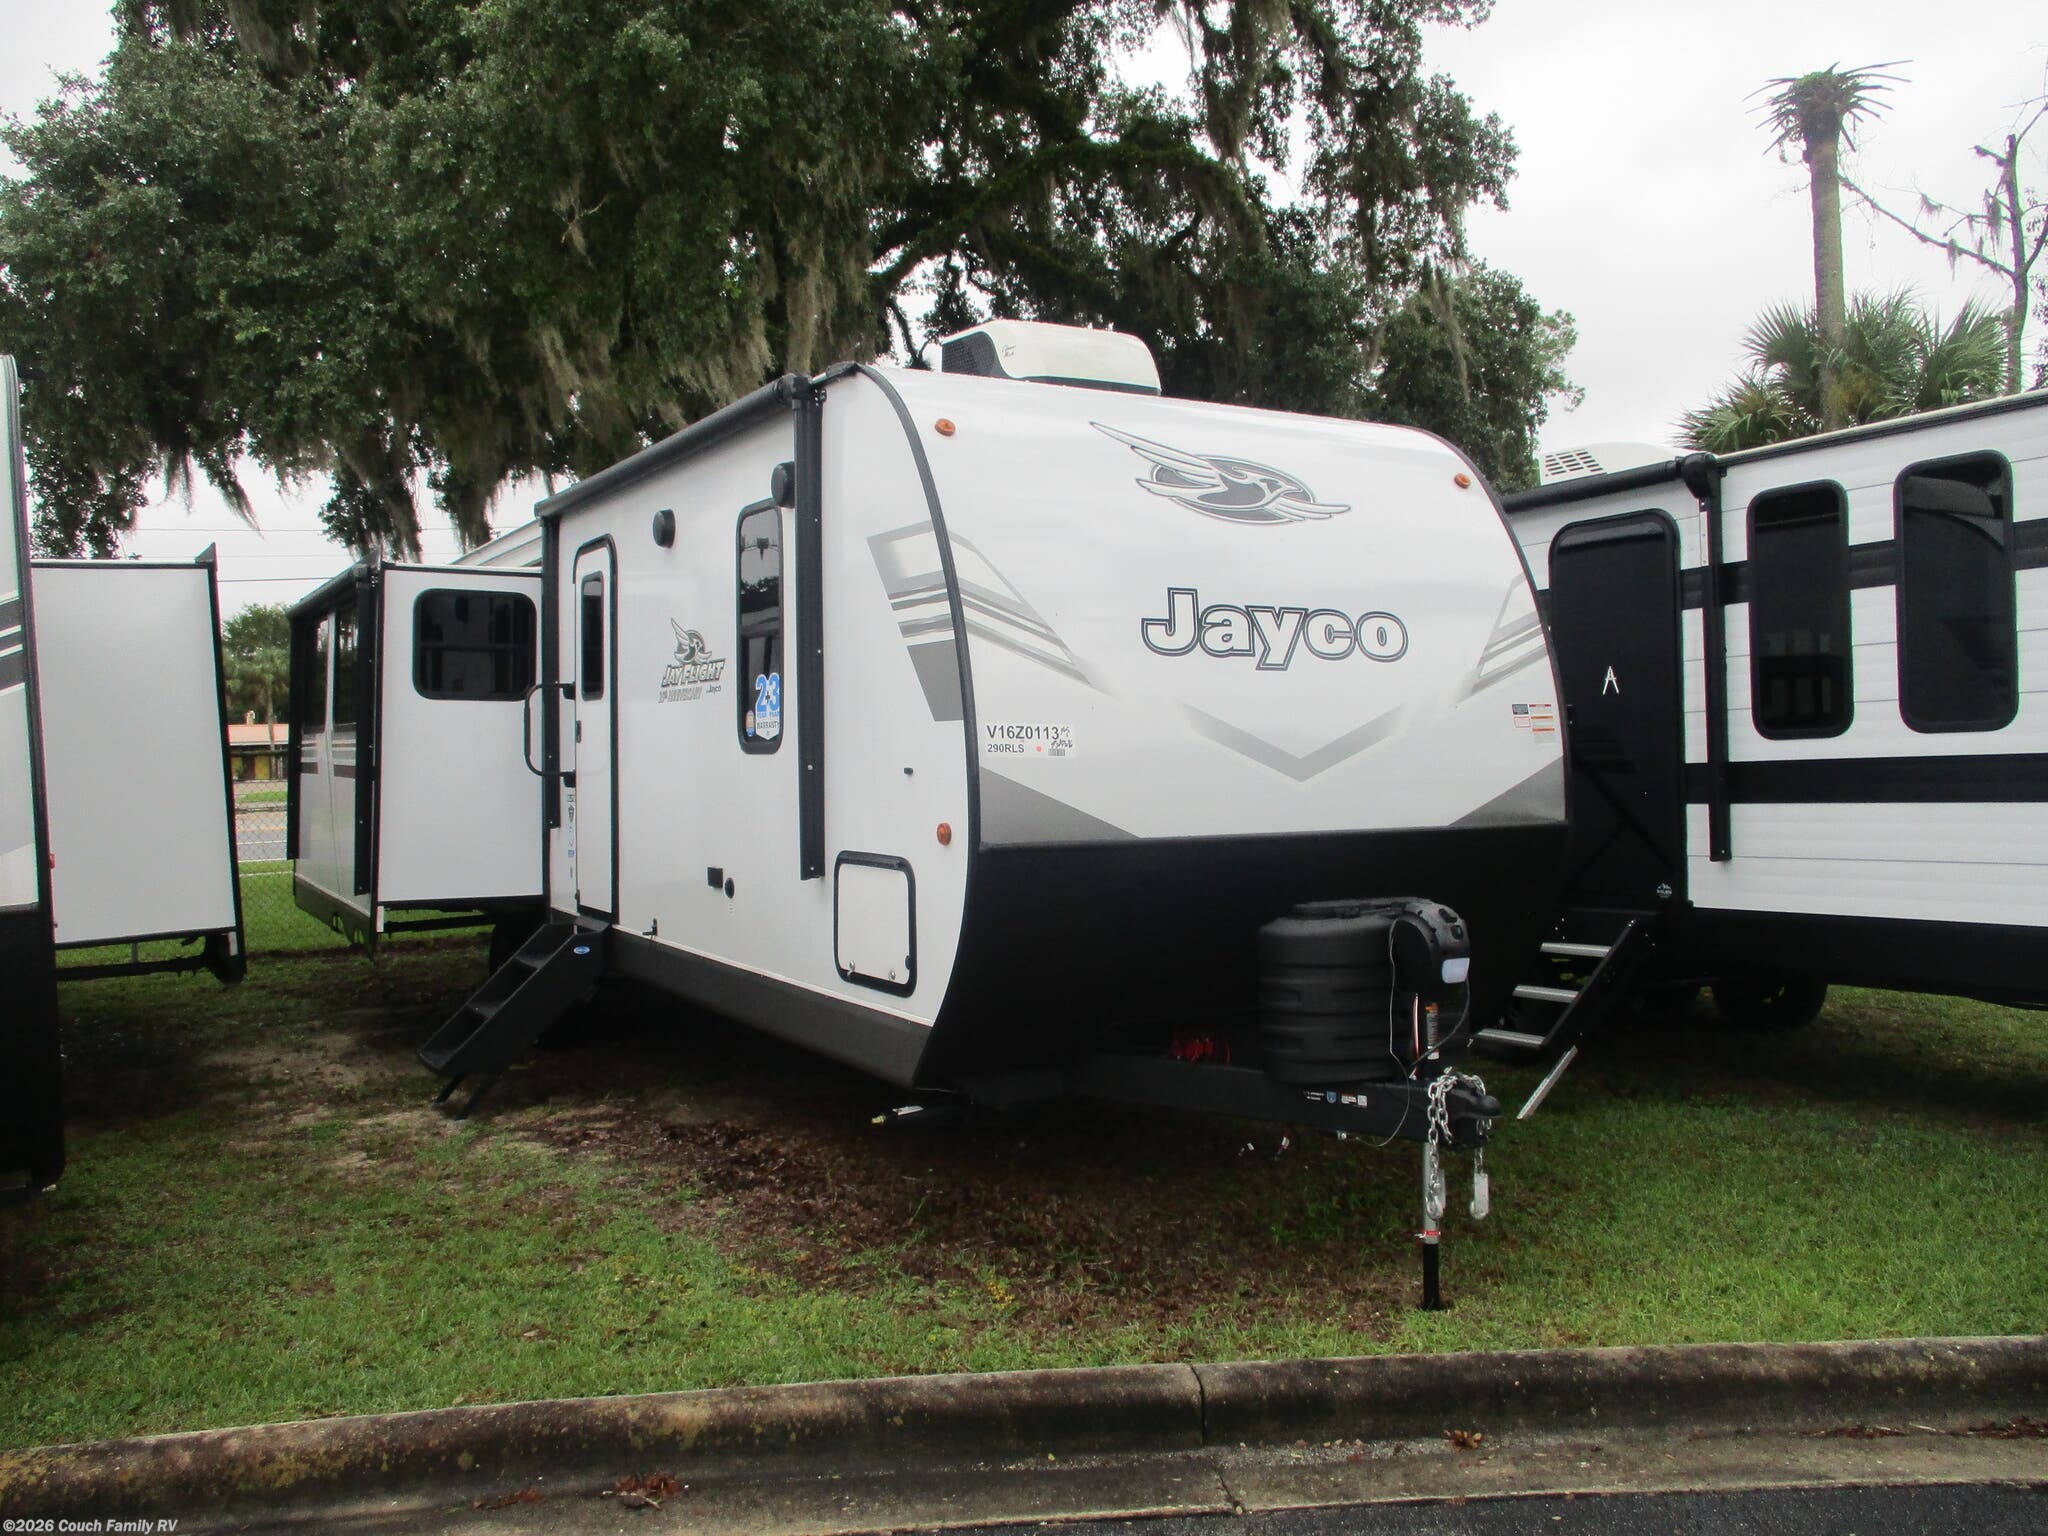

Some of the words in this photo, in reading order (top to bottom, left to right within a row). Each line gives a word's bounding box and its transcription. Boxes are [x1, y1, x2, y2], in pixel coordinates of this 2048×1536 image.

[1141, 587, 1409, 671] Jayco
[661, 664, 683, 687] JAY
[679, 658, 726, 687] FLIGHT
[986, 725, 1060, 740] V16Z0113
[987, 743, 1025, 753] 290RLS
